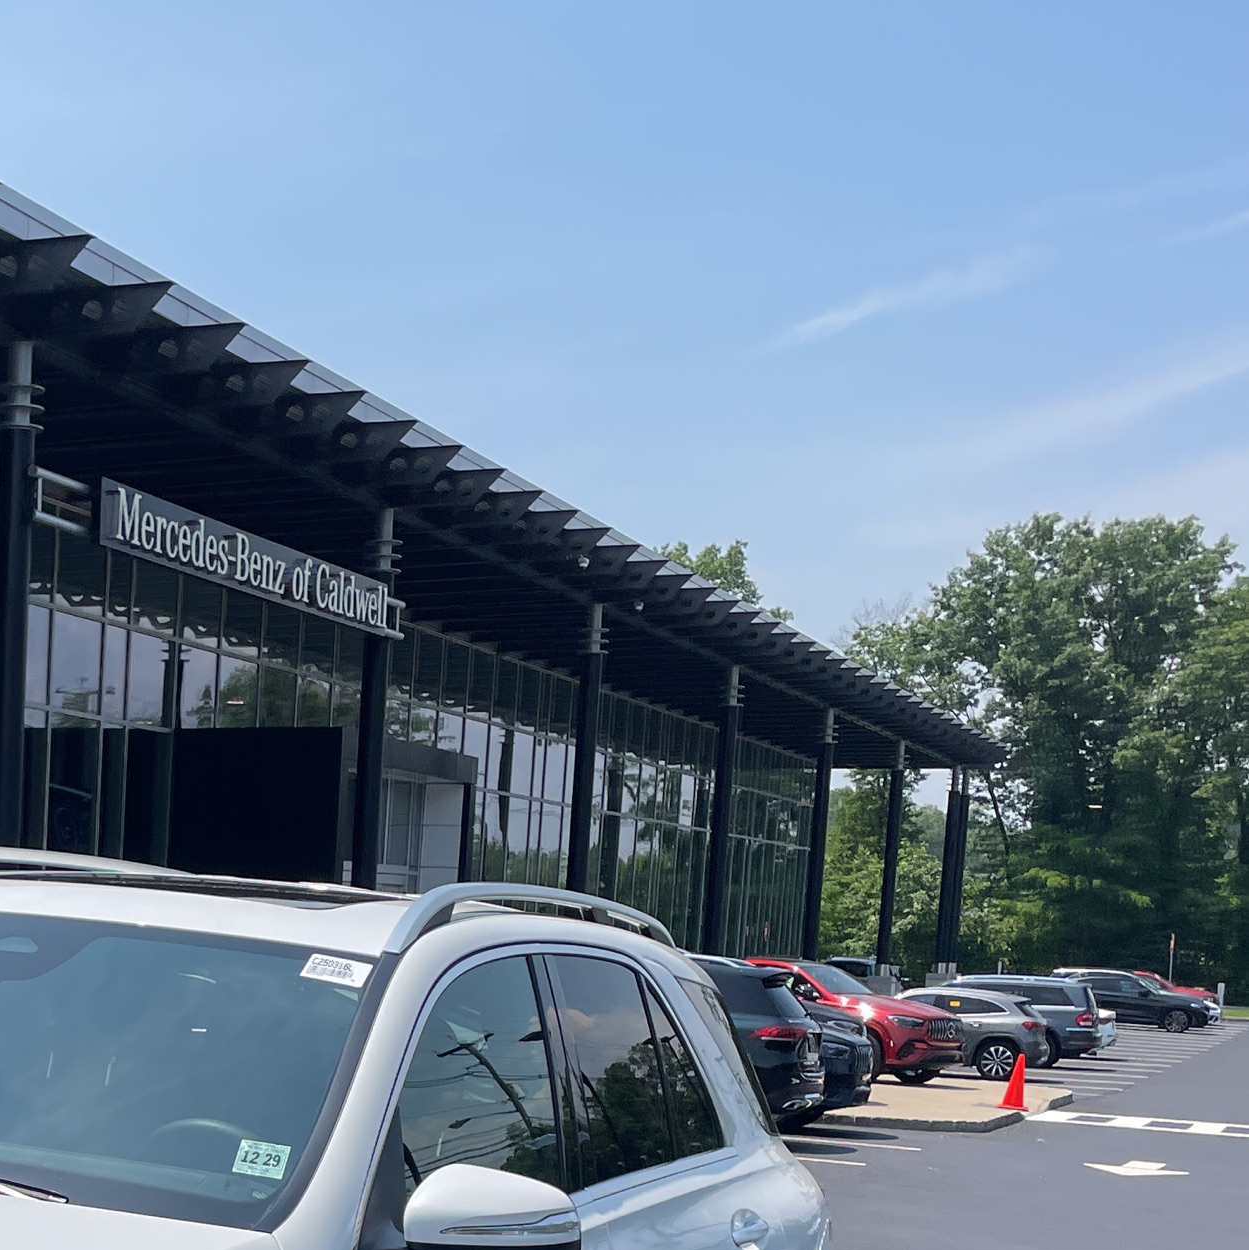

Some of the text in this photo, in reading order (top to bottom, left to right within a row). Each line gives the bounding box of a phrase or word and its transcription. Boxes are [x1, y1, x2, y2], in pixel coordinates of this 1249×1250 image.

[115, 487, 388, 629] Mercedes-Benz of Caldwell
[240, 1149, 281, 1168] 12 29
